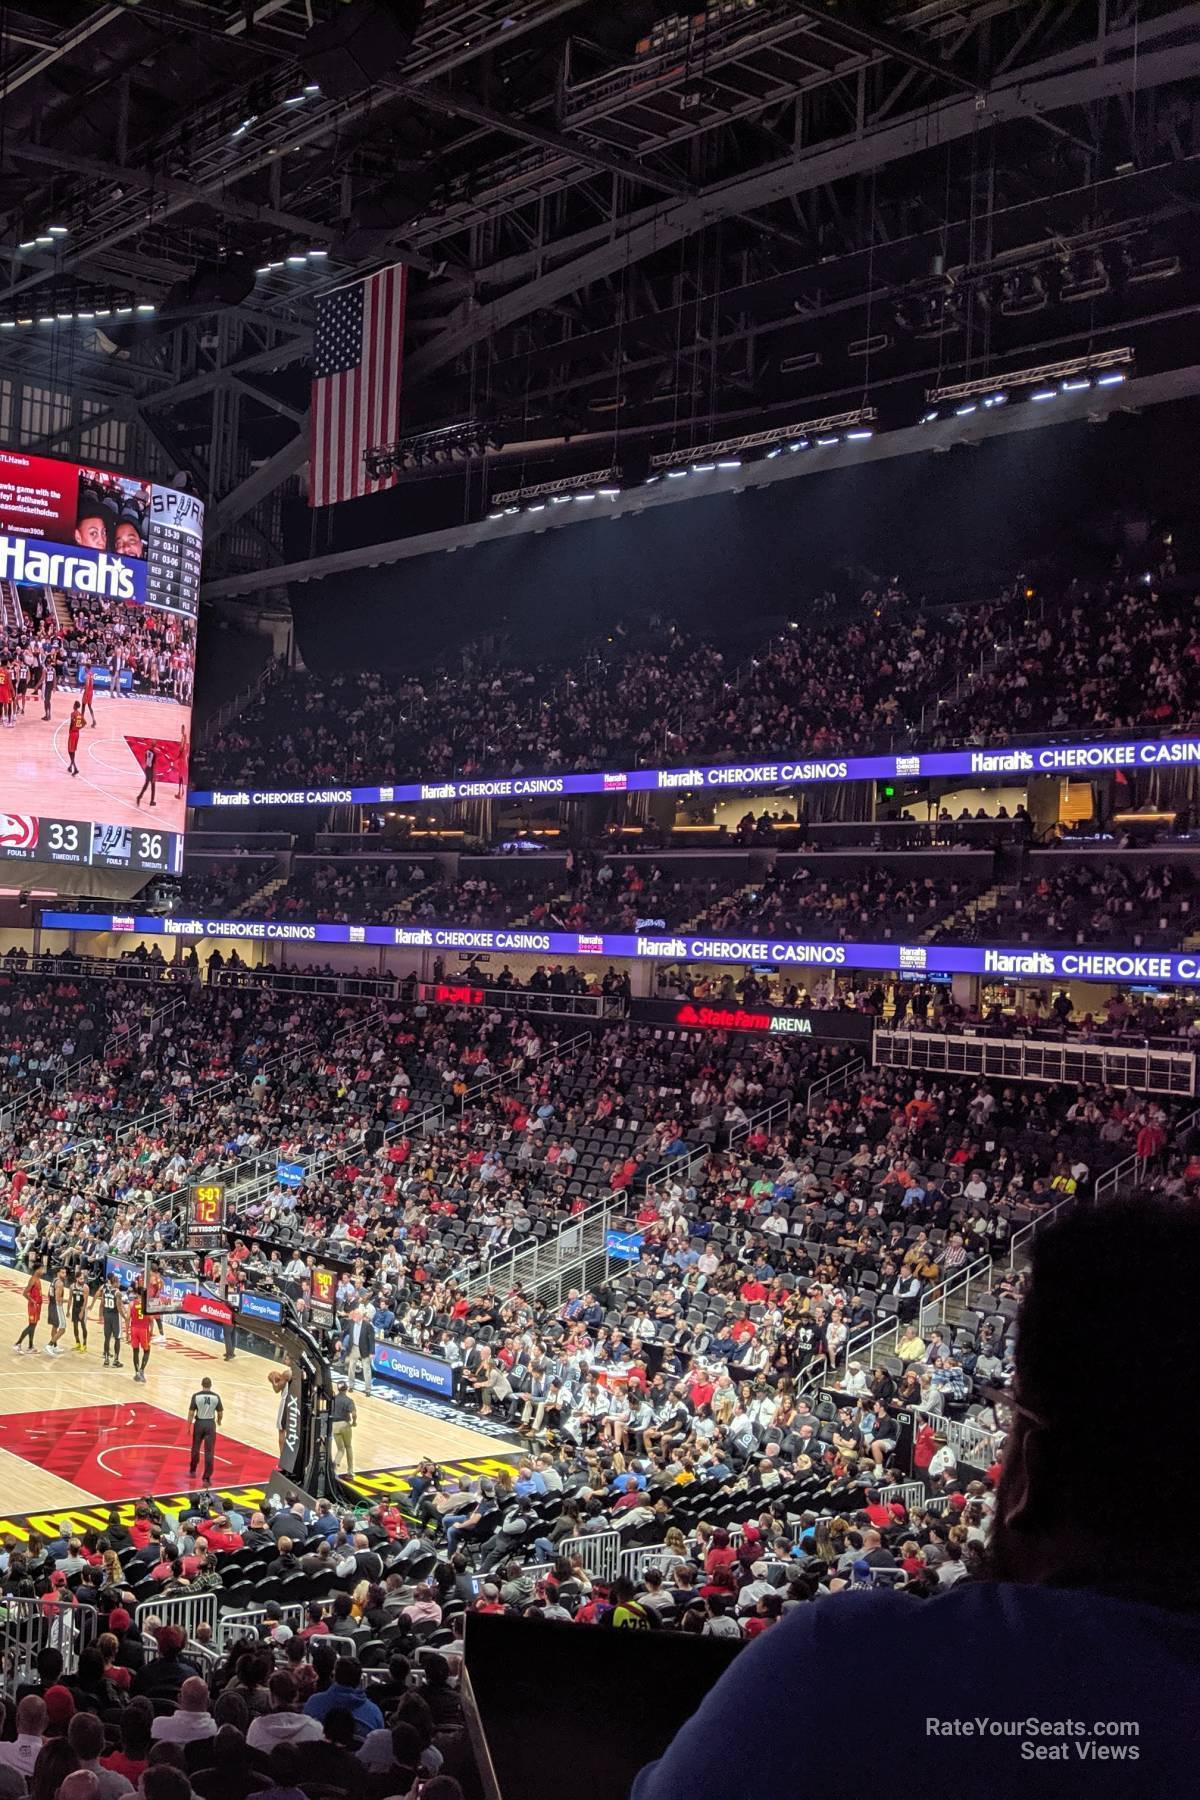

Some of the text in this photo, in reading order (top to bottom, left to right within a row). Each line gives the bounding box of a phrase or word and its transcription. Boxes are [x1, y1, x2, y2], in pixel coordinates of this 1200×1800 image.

[16, 485, 34, 495] game
[36, 487, 49, 497] with
[50, 490, 61, 499] the
[163, 542, 179, 554] 03-11
[166, 570, 174, 579] 23
[1039, 746, 1135, 767] CHEROKEE
[708, 767, 777, 784] CHEROKEE
[781, 763, 847, 780] CASINOS
[459, 782, 511, 796] CHEROKEE
[514, 779, 563, 793] CASINOS
[253, 792, 305, 804] CHEROKEE
[307, 791, 352, 803] CASINOS
[48, 824, 79, 850] 33
[7, 849, 26, 858] FOULS
[138, 833, 162, 859] 36
[52, 853, 80, 862] TIMEOUTS
[106, 858, 122, 866] FOULS
[207, 921, 265, 937] CHEROKEE
[268, 924, 316, 939] CASINOS
[436, 931, 493, 947] CHEROKEE
[496, 934, 550, 950] CASINOS
[692, 941, 768, 960] CHEROKEE
[772, 945, 845, 963] CASINOS
[1062, 955, 1171, 977] CHEROKEE
[770, 1016, 812, 1033] ARENA
[199, 1187, 220, 1201] 5:07
[202, 1201, 216, 1221] 12
[105, 1298, 115, 1308] 10
[250, 1302, 280, 1317] Georgia Power
[391, 1358, 445, 1386] Georgia Power
[286, 1394, 300, 1452] xfinity
